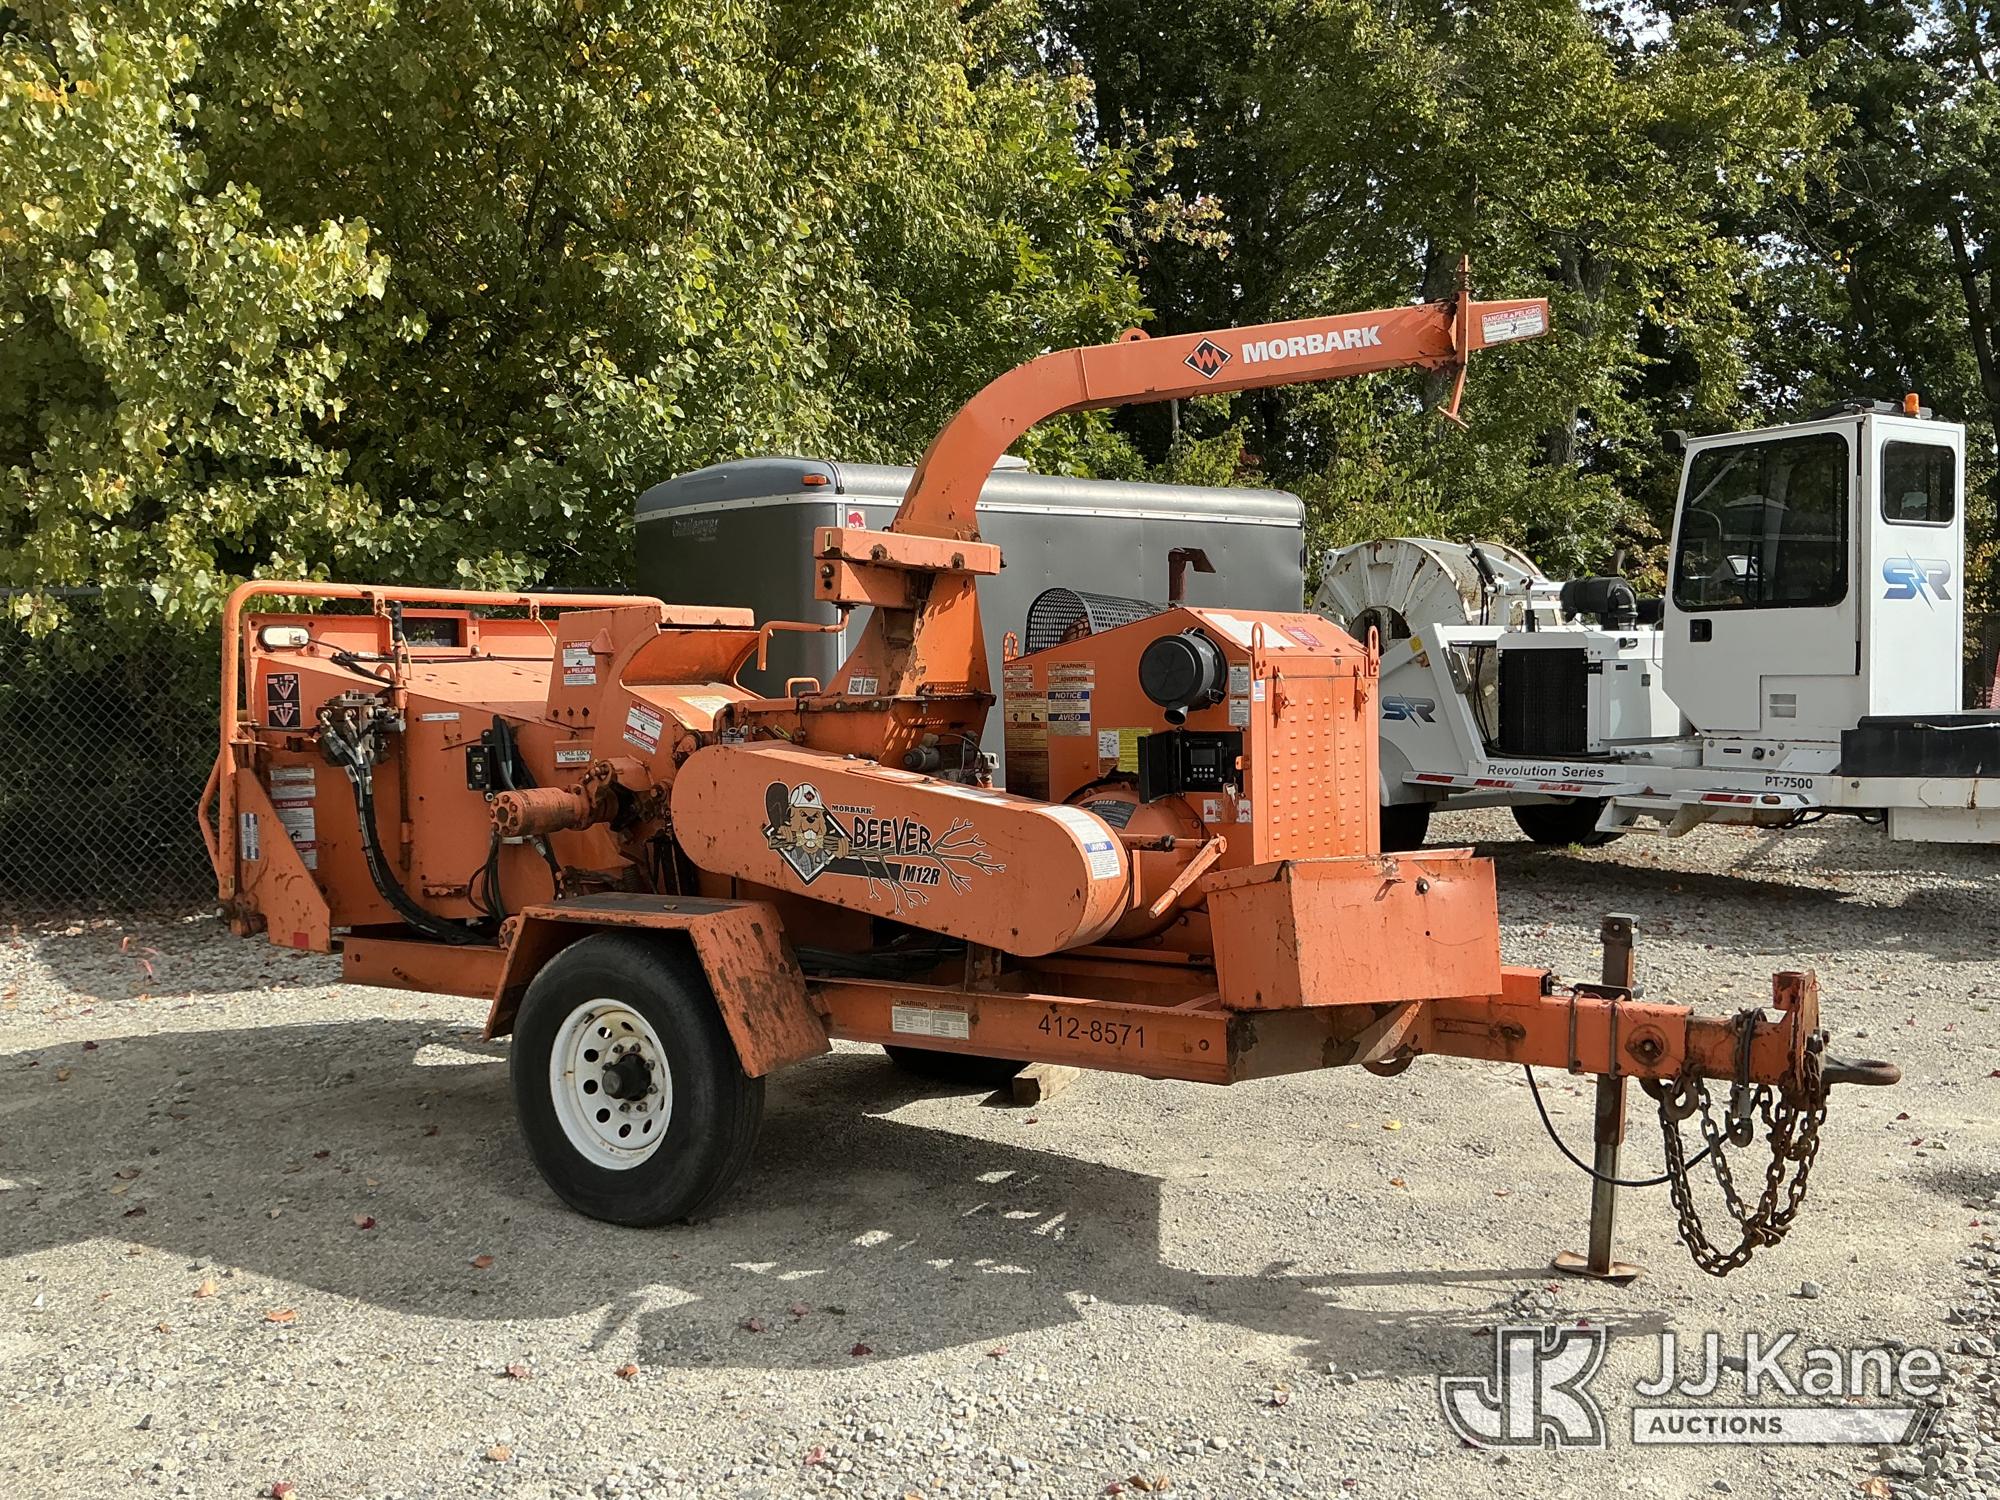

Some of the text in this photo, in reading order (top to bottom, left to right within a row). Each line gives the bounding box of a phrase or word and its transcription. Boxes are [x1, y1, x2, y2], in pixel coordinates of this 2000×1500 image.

[1483, 312, 1509, 323] DANGER
[1514, 303, 1541, 318] PELIGRO
[1241, 325, 1382, 364] MORBARK
[1882, 557, 1953, 601] SR
[1382, 695, 1436, 723] SR
[1487, 764, 1605, 778] Revolution Series
[1764, 775, 1814, 790] PT-7500
[831, 804, 874, 815] MORBARK
[853, 816, 932, 855] BEEVER
[902, 864, 941, 886] M12R
[1037, 1014, 1146, 1049] 412-8571
